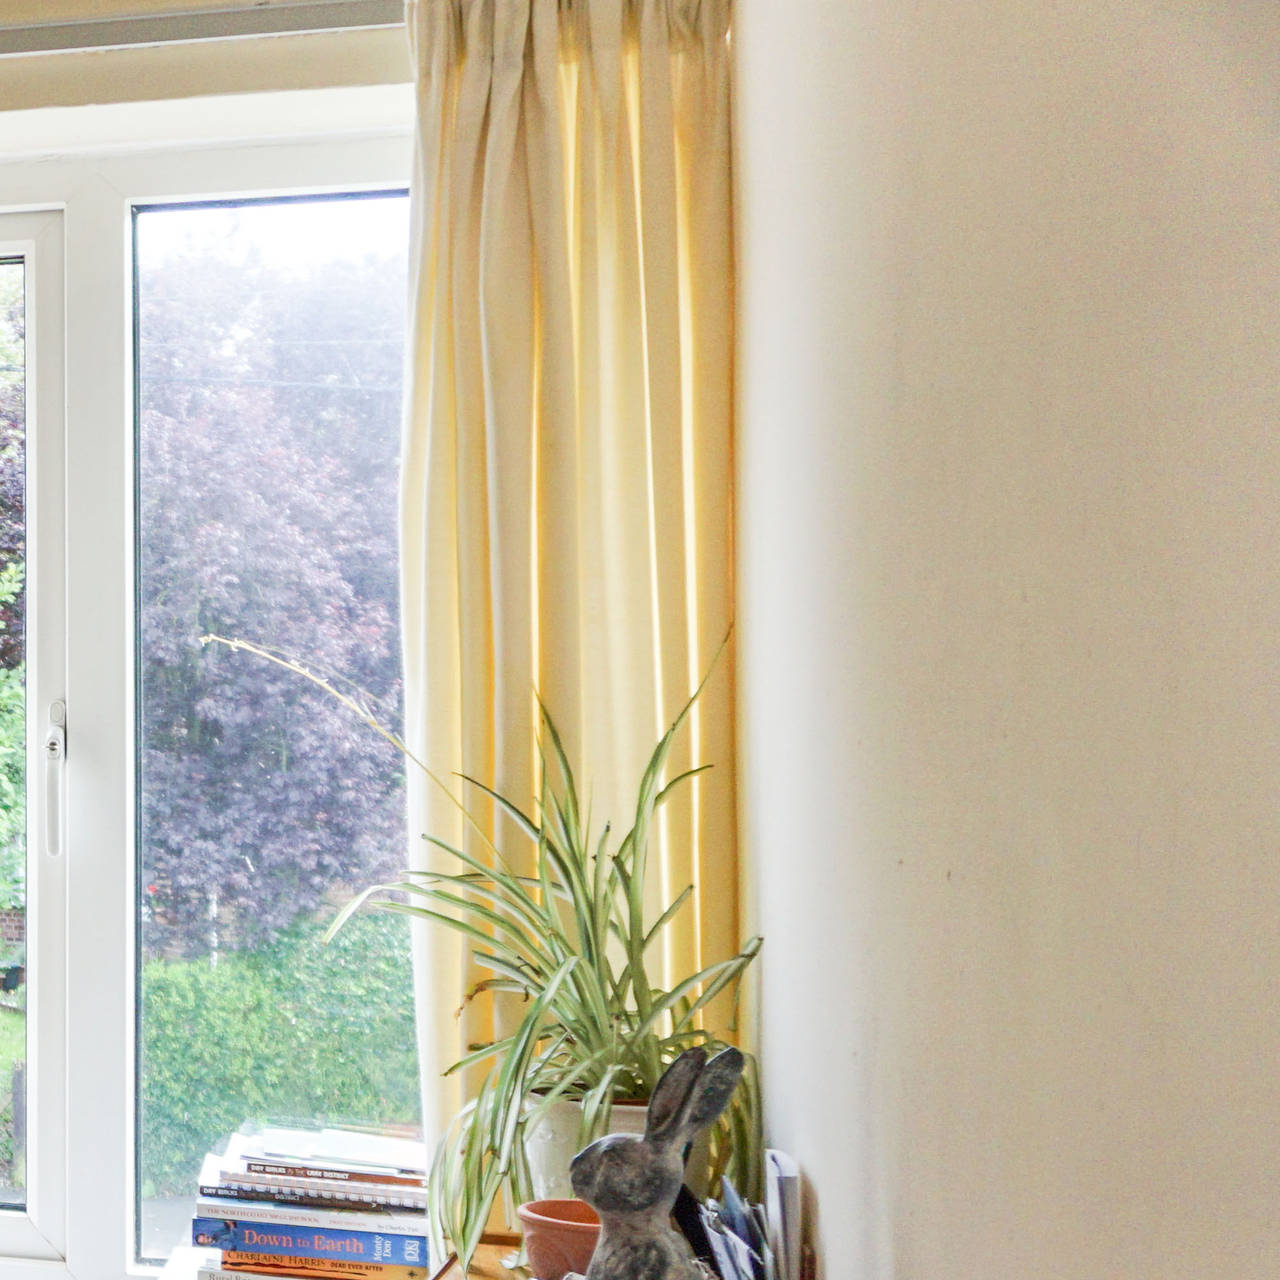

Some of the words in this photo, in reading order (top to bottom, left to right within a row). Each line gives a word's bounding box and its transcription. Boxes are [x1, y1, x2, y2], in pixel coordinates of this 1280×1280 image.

[244, 1229, 293, 1248] Down
[297, 1236, 310, 1247] to
[313, 1236, 364, 1254] Earth
[374, 1234, 383, 1261] Monty
[383, 1240, 392, 1258] Don
[405, 1239, 420, 1262] DK
[227, 1250, 285, 1264] CHARLAINE
[289, 1255, 325, 1267] HARRIS
[330, 1261, 346, 1269] DEAD
[348, 1262, 364, 1271] EVER
[365, 1264, 383, 1272] AFTER
